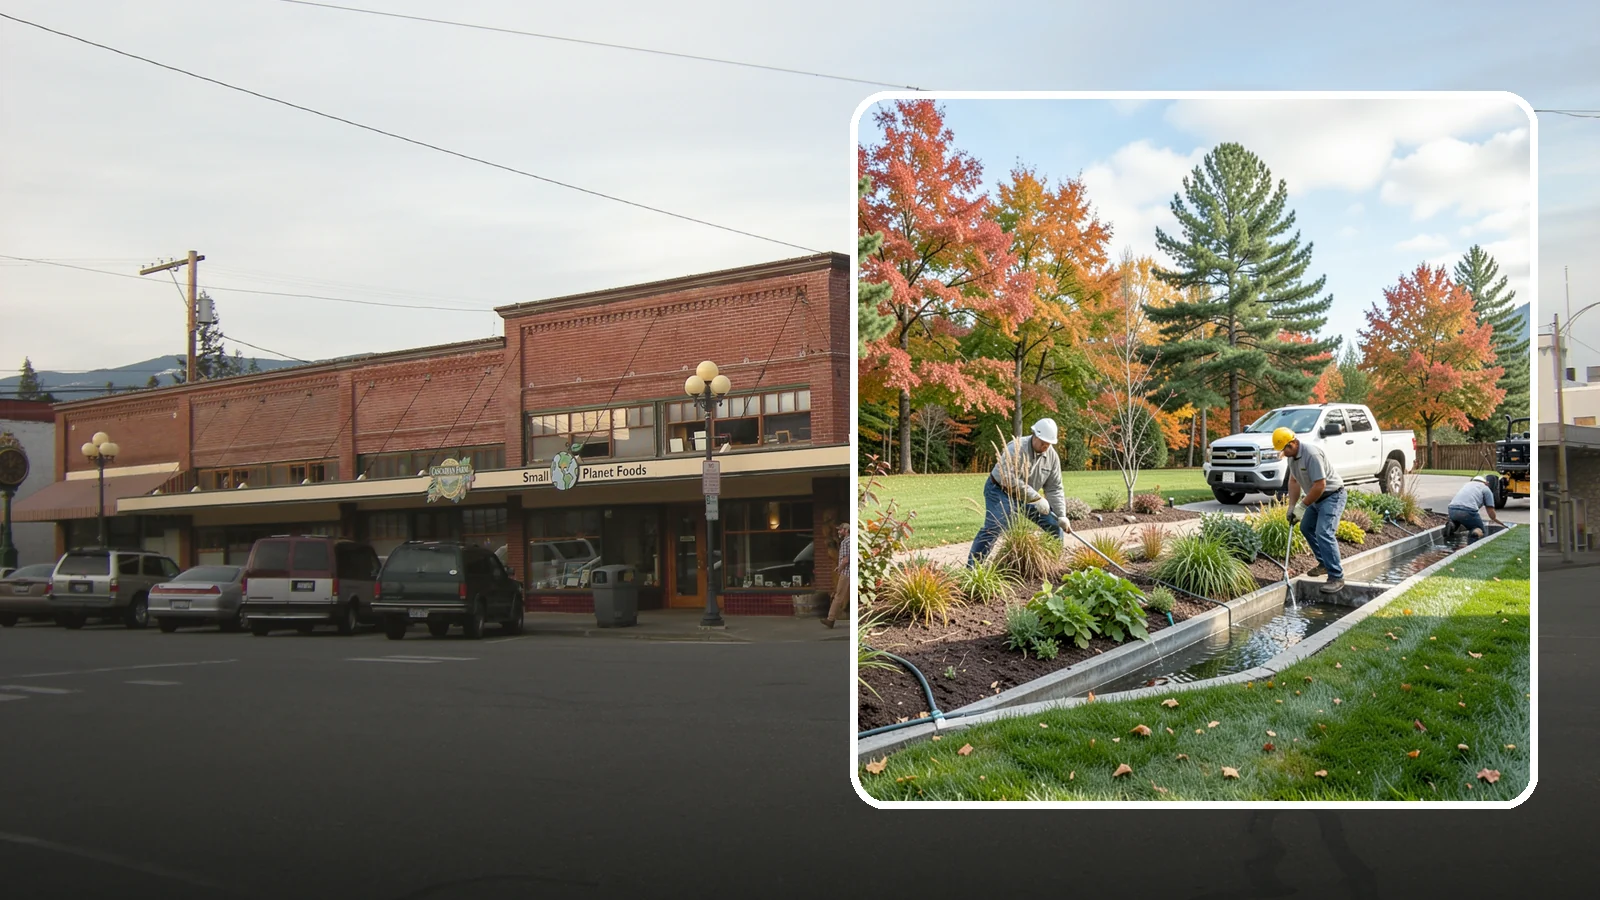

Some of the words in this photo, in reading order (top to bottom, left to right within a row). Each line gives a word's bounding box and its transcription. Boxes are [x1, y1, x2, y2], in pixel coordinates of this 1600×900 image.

[522, 471, 549, 483] Small
[582, 467, 614, 479] Planet
[616, 464, 647, 477] Foods
